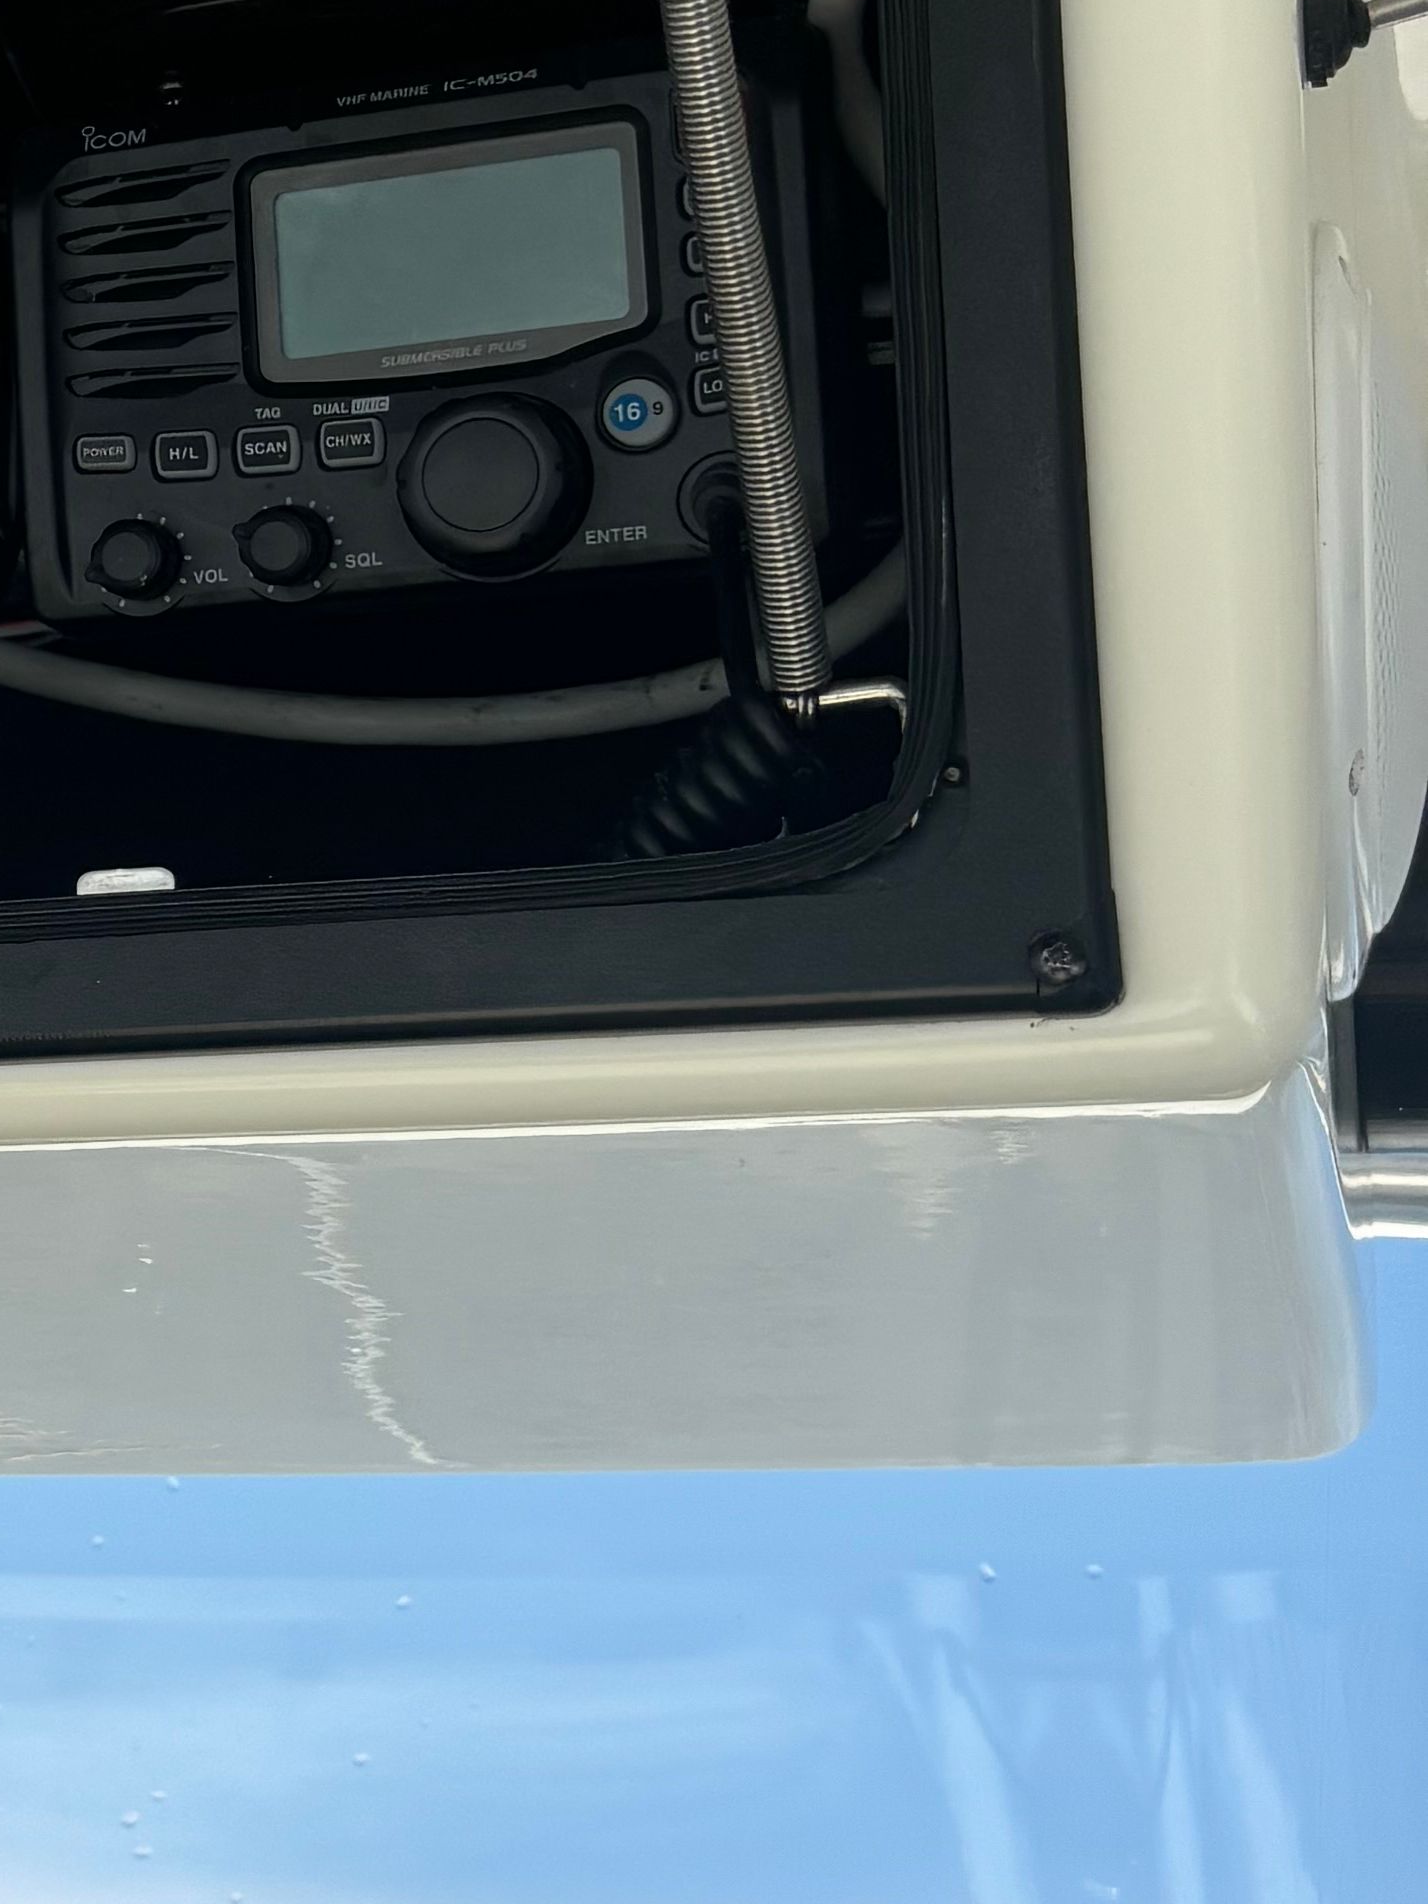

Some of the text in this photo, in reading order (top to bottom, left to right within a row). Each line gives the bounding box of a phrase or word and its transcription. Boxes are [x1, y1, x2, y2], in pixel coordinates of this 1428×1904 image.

[336, 67, 539, 108] VHF MARINE IC-M504
[488, 337, 528, 356] PLUS
[254, 406, 282, 421] TAG
[313, 402, 350, 417] DUAL
[613, 400, 665, 425] 16 9
[243, 439, 288, 457] SCAN
[324, 431, 373, 450] CH/WX
[81, 444, 125, 460] POWER
[168, 446, 200, 462] H/L
[584, 524, 648, 545] ENTER
[343, 551, 384, 571] SQL
[192, 567, 229, 586] VOL
